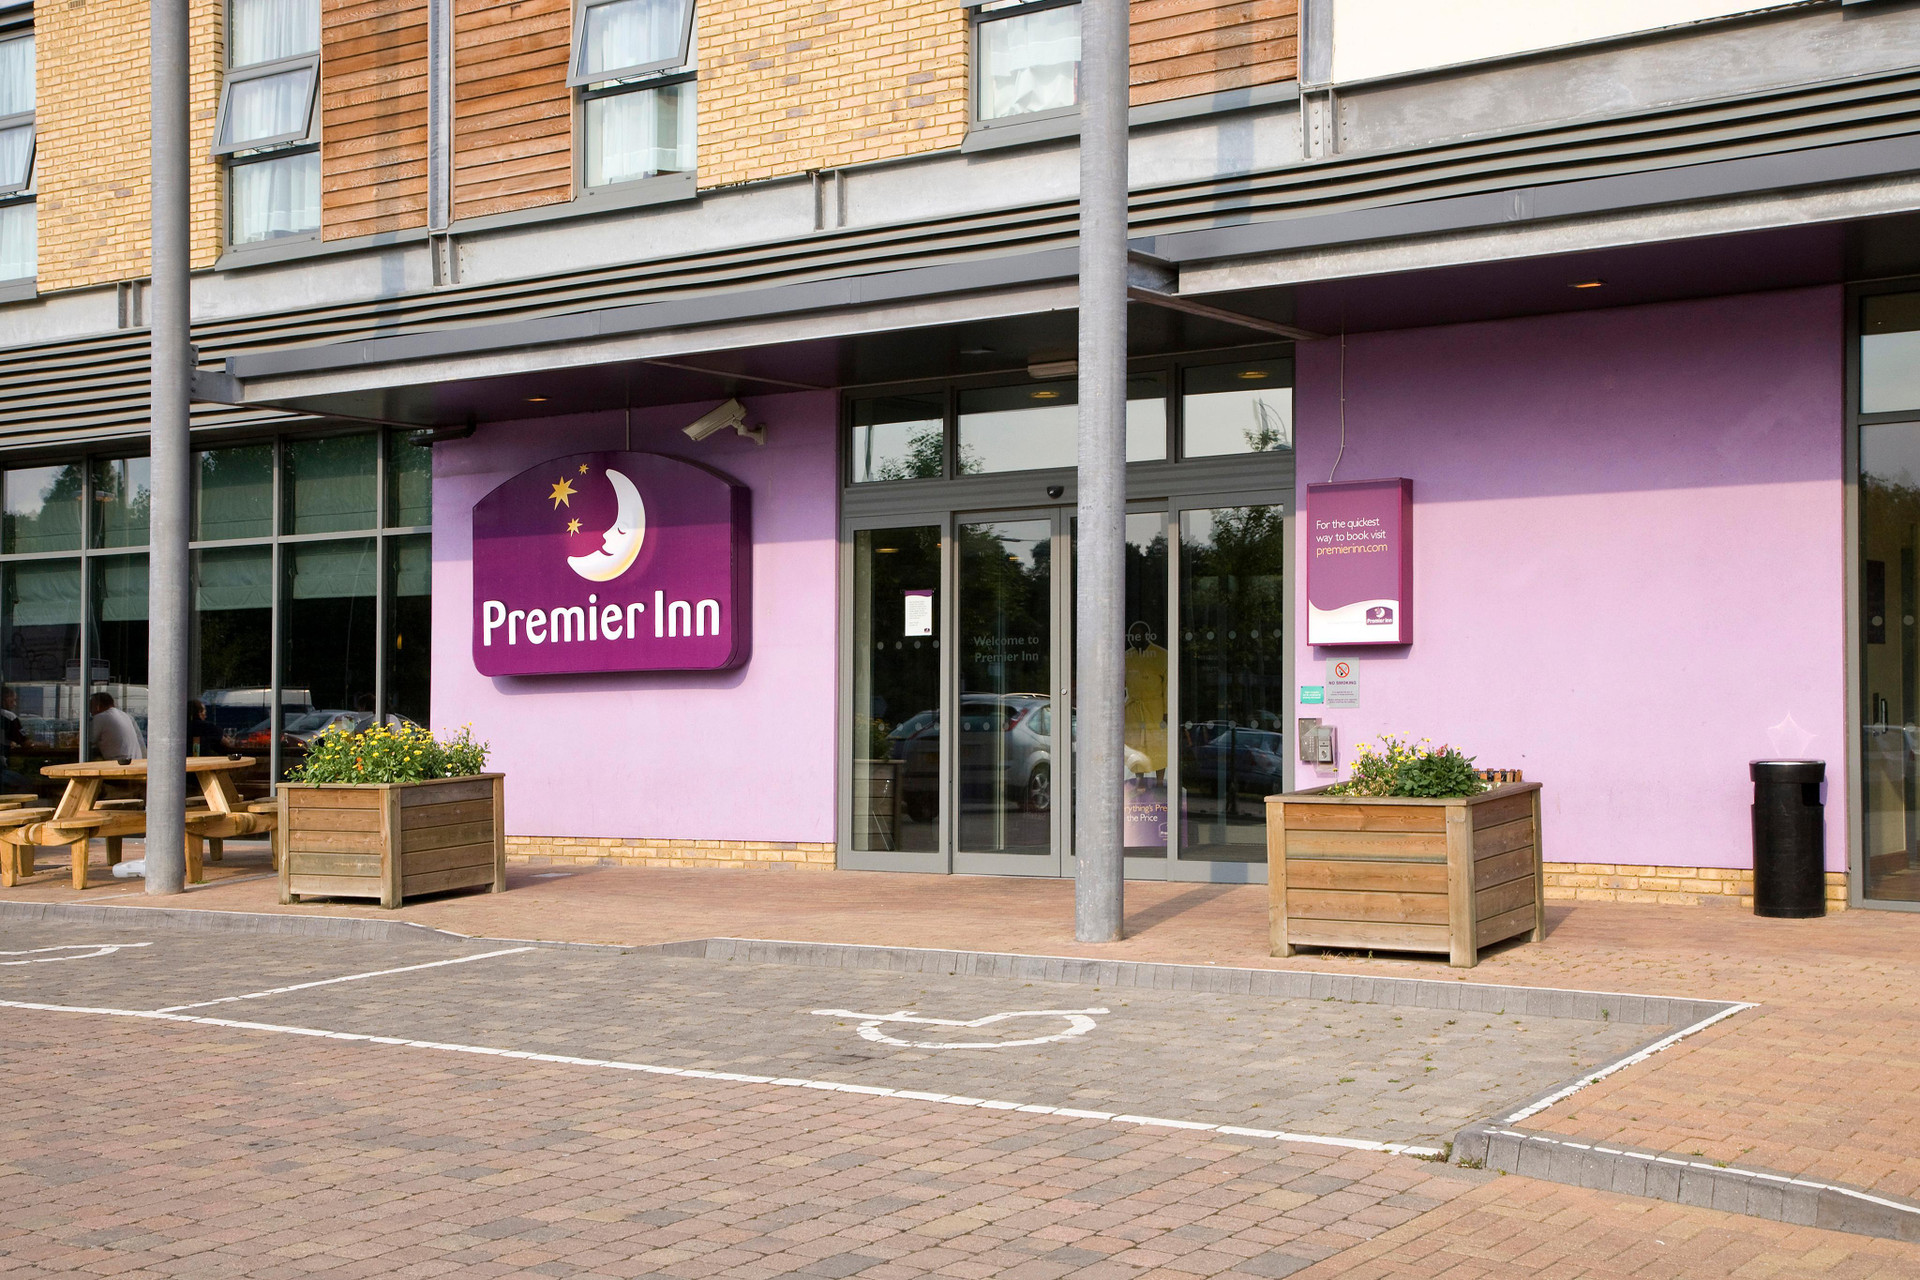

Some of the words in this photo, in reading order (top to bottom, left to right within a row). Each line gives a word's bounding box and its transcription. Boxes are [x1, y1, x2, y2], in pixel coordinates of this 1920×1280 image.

[1316, 519, 1331, 530] For
[1332, 518, 1346, 529] the
[1347, 517, 1380, 530] quickest
[1316, 534, 1333, 545] way
[1335, 532, 1345, 542] to
[1346, 530, 1370, 541] book
[1370, 529, 1387, 540] visit
[1316, 543, 1388, 559] premierinn.com
[482, 593, 646, 647] Premier
[654, 590, 720, 639] Inn
[973, 635, 1025, 647] Welcome
[1027, 635, 1040, 646] to
[974, 651, 1019, 663] Premier
[1021, 650, 1039, 662] Inn
[1126, 813, 1139, 822] the
[1140, 813, 1158, 822] Price
